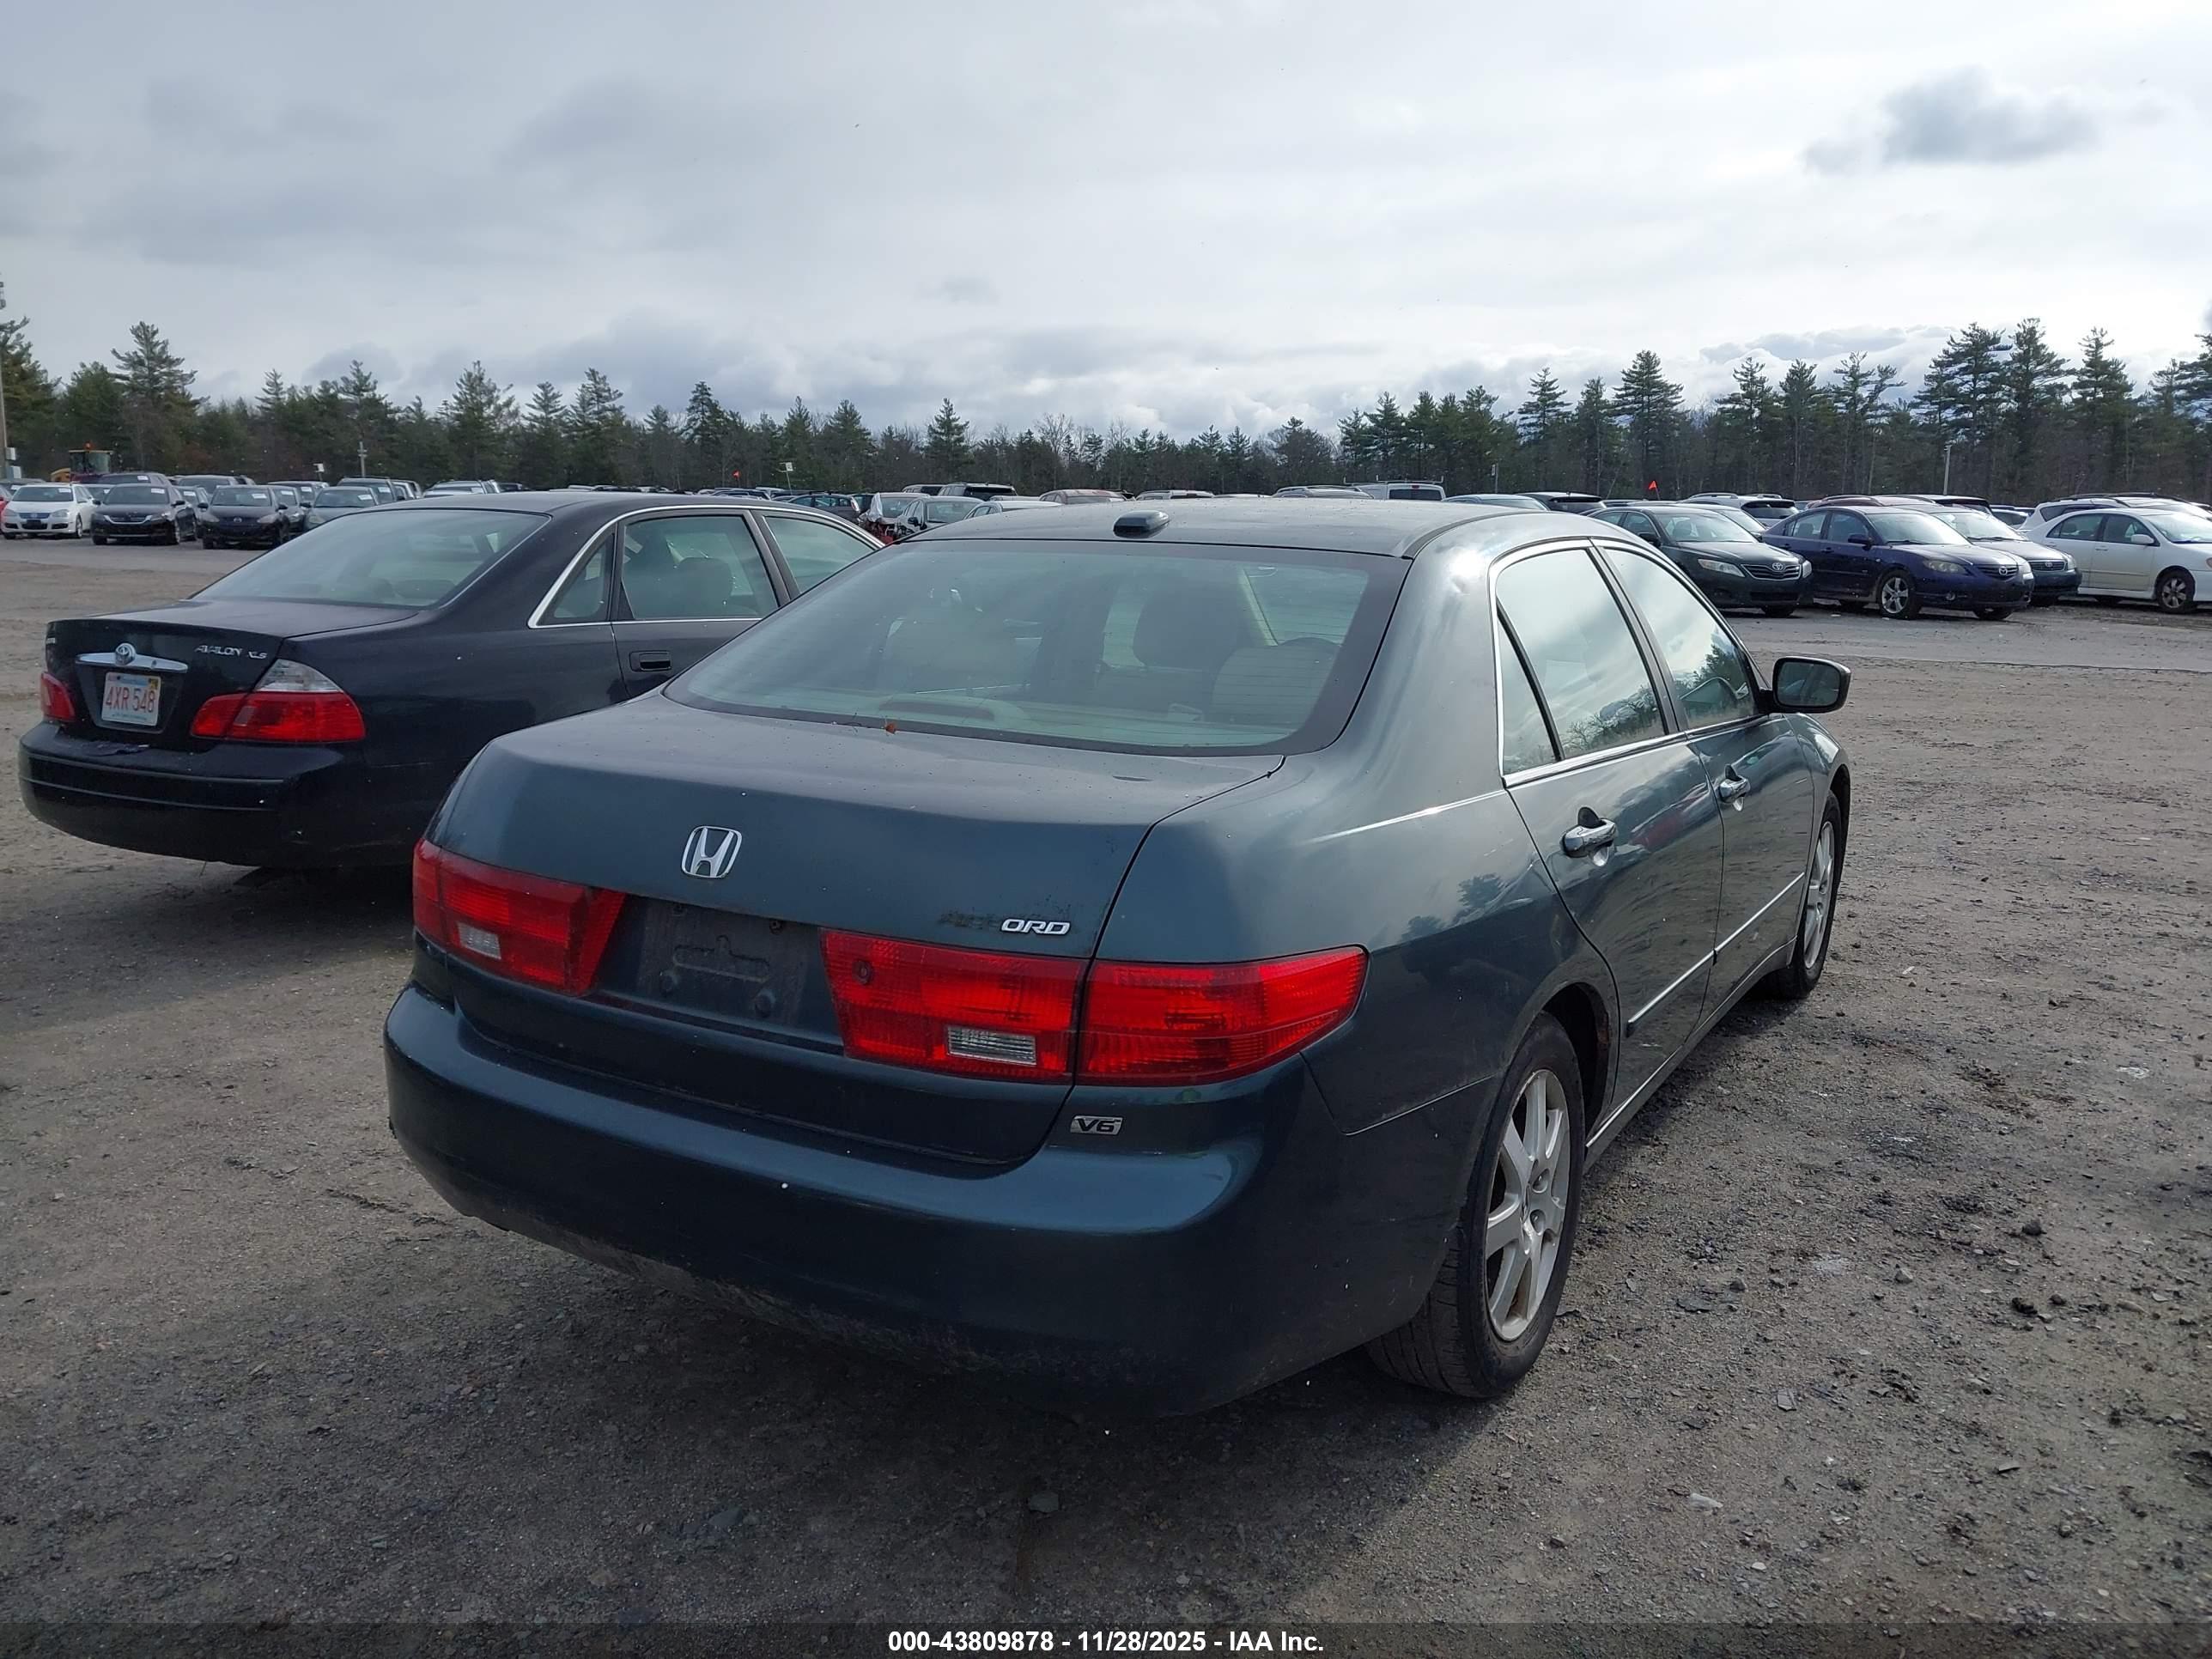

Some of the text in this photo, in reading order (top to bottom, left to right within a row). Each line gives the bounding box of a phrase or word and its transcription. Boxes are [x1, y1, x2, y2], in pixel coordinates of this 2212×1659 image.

[106, 686, 155, 713] 4XR 548
[1076, 1117, 1118, 1133] V6
